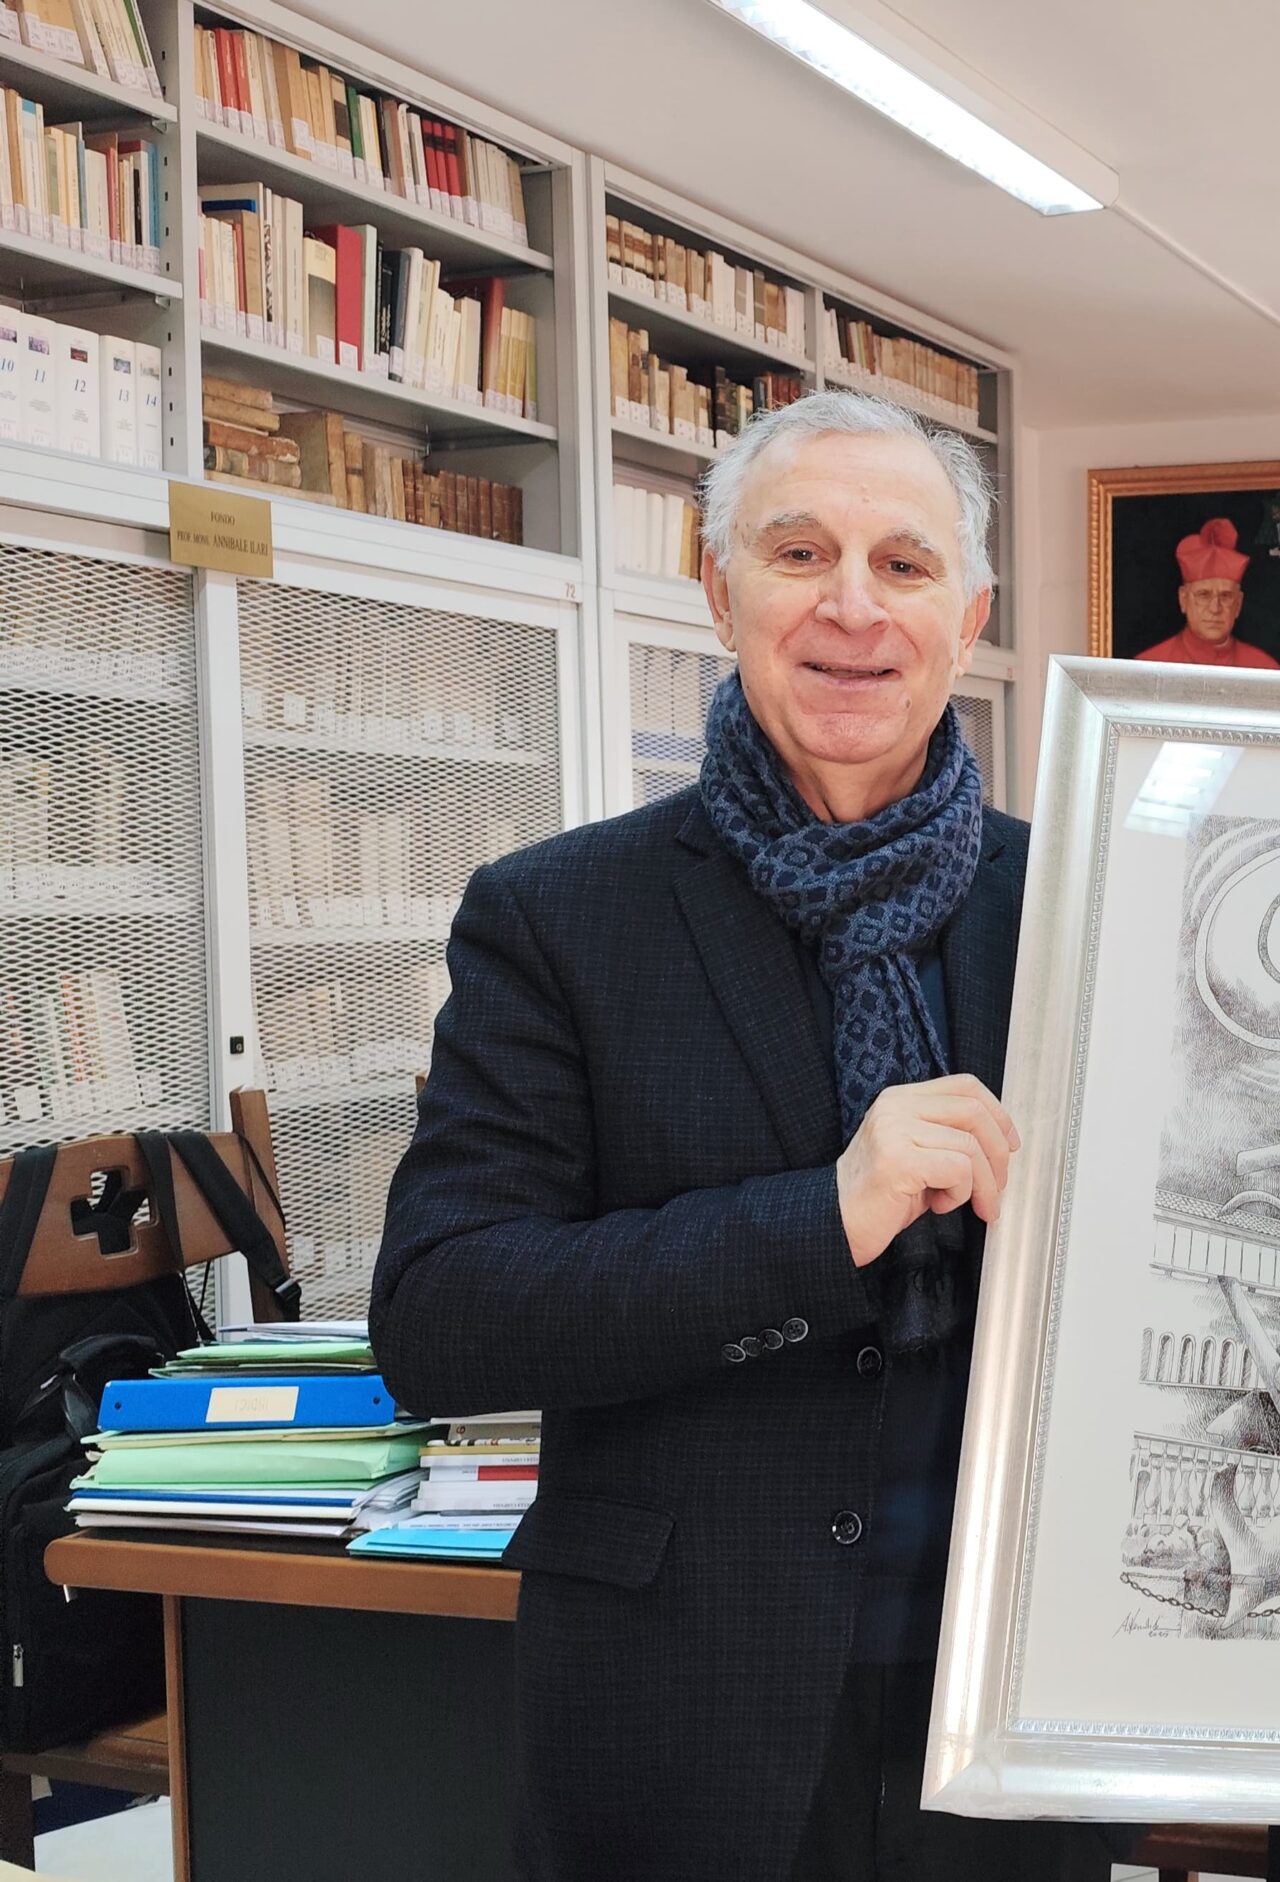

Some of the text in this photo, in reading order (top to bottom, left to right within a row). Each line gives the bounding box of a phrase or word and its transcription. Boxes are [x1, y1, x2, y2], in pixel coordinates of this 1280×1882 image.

[0, 357, 15, 372] 10
[34, 368, 46, 383] 11
[73, 378, 87, 393] 12
[118, 388, 130, 402] 13
[146, 393, 157, 407] 14
[210, 511, 236, 526] FONDO
[213, 534, 248, 553] ANNIBALE
[249, 541, 269, 556] ILARI
[564, 581, 577, 599] 72
